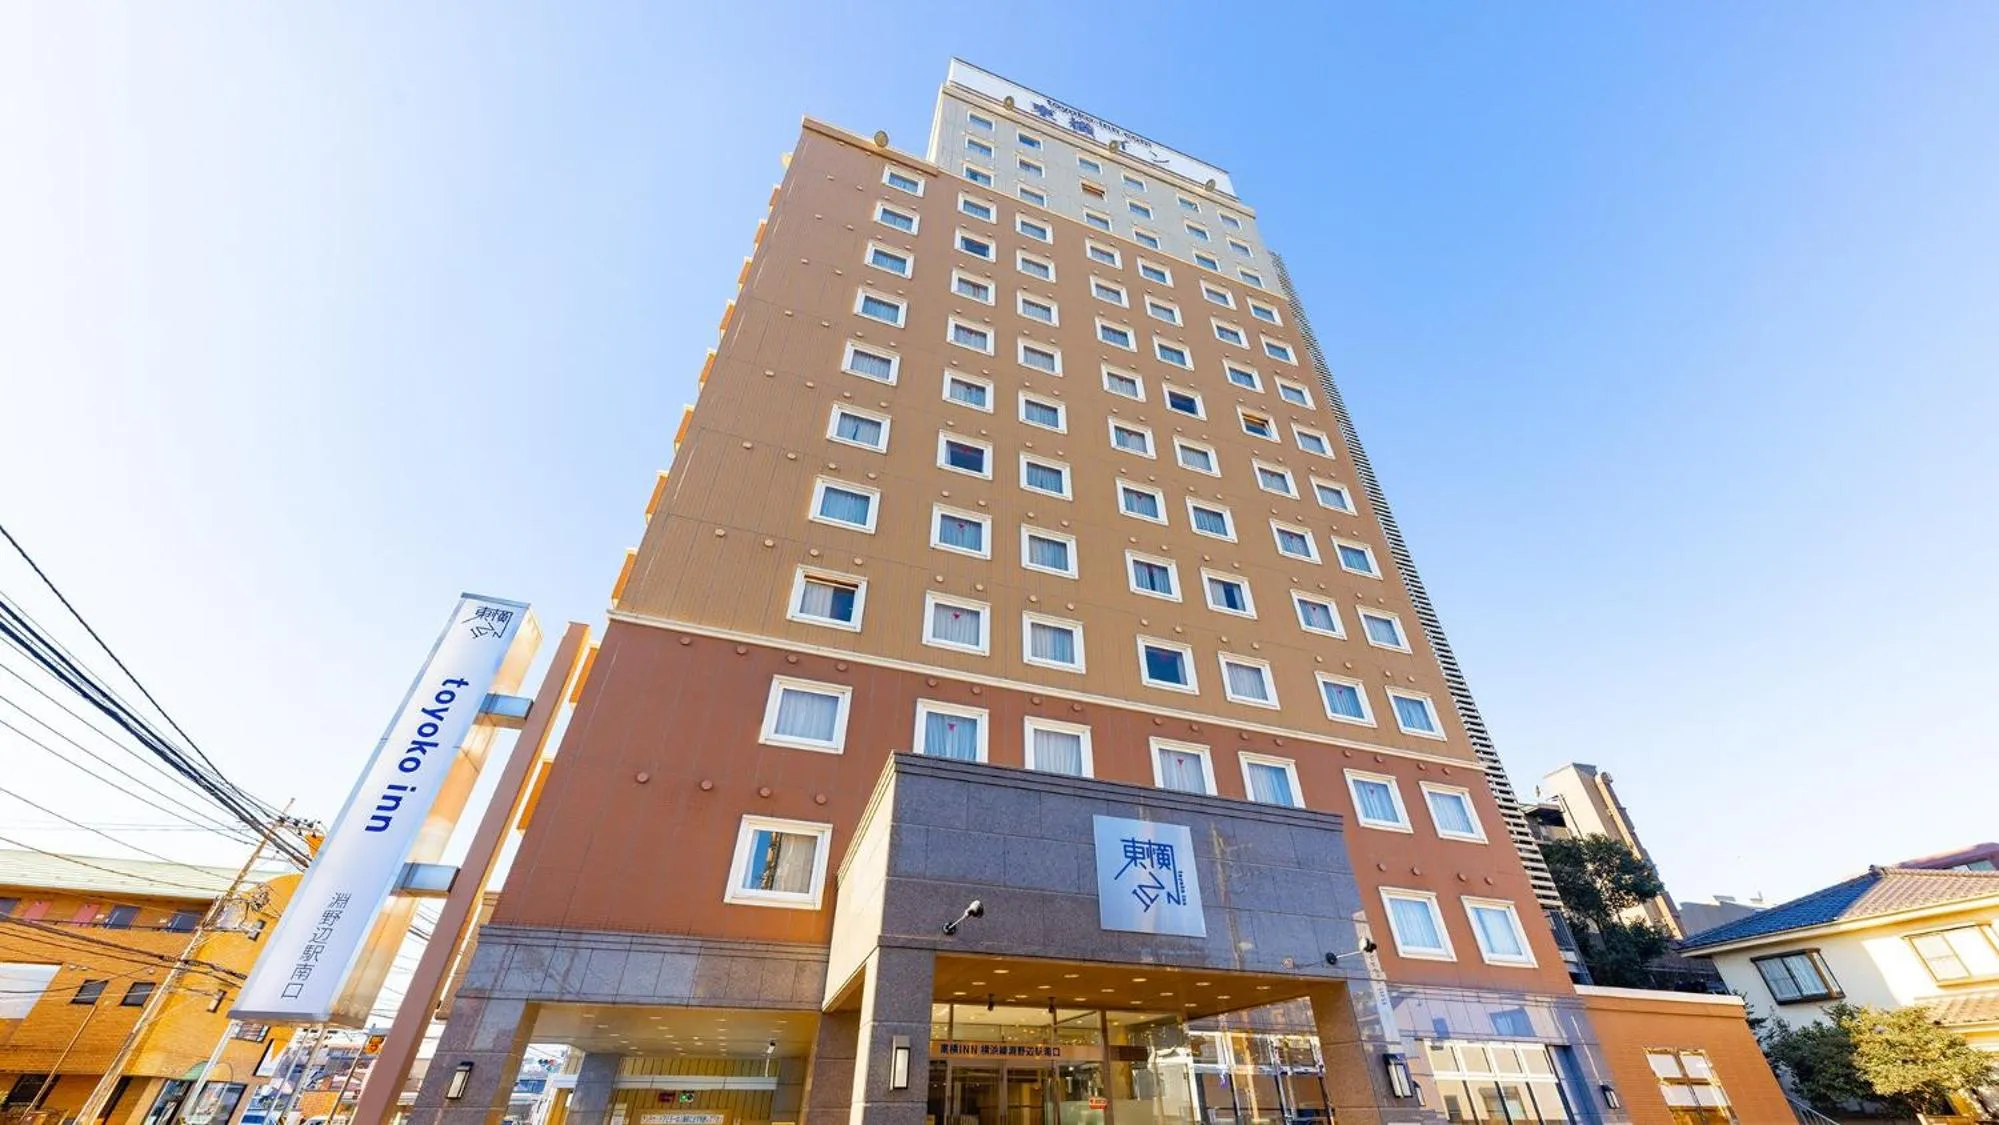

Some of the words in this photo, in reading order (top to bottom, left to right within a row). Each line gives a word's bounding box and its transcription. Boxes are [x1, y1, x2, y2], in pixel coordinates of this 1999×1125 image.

[398, 678, 469, 774] toyoko
[365, 784, 416, 832] inn
[280, 891, 352, 999] 淵野辺駅南口
